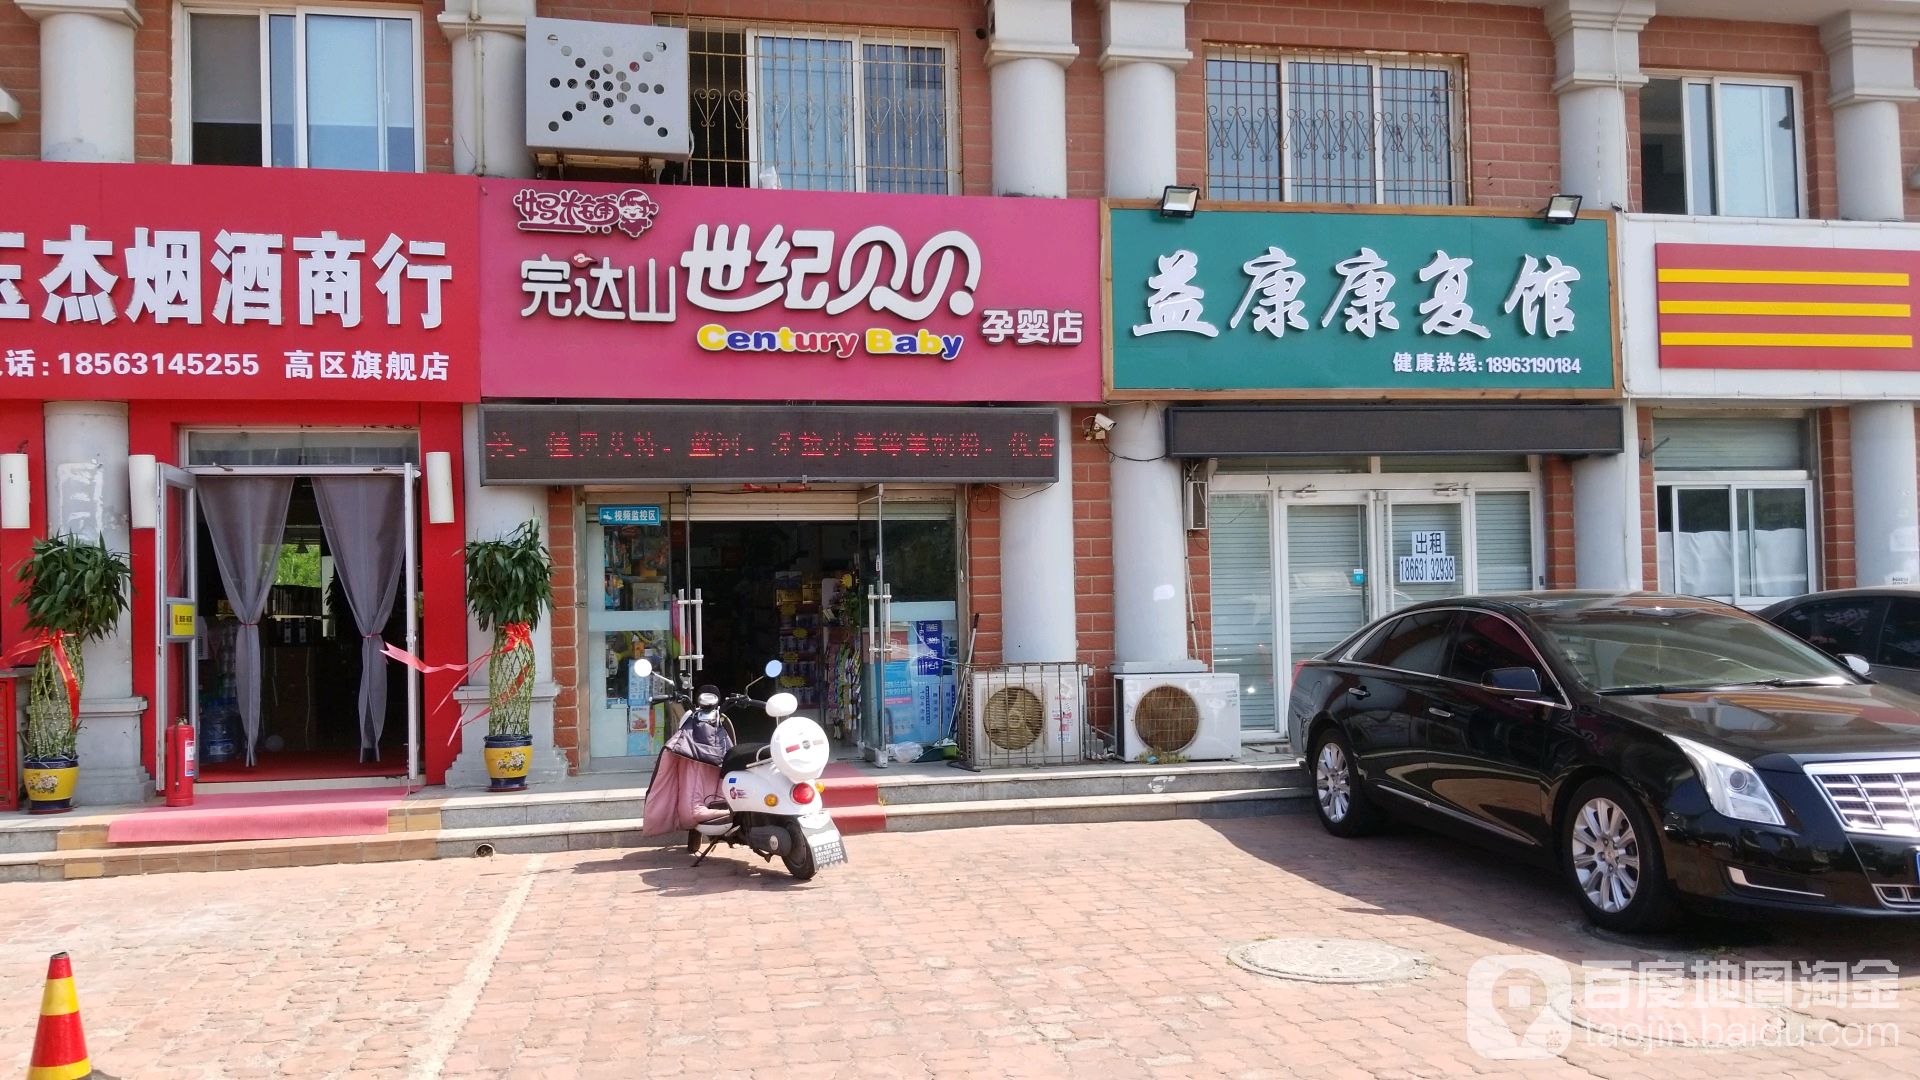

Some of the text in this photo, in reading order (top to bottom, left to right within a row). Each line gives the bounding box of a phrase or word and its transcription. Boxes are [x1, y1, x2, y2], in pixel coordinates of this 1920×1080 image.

[521, 254, 676, 322] 完达山
[981, 309, 1084, 345] 孕婴店
[1133, 246, 1581, 338] 益康康复馆
[697, 324, 964, 360] Century Baby
[283, 350, 450, 381] 高区旗舰店
[615, 510, 656, 521] 视频监控区
[1416, 532, 1442, 555] 出租
